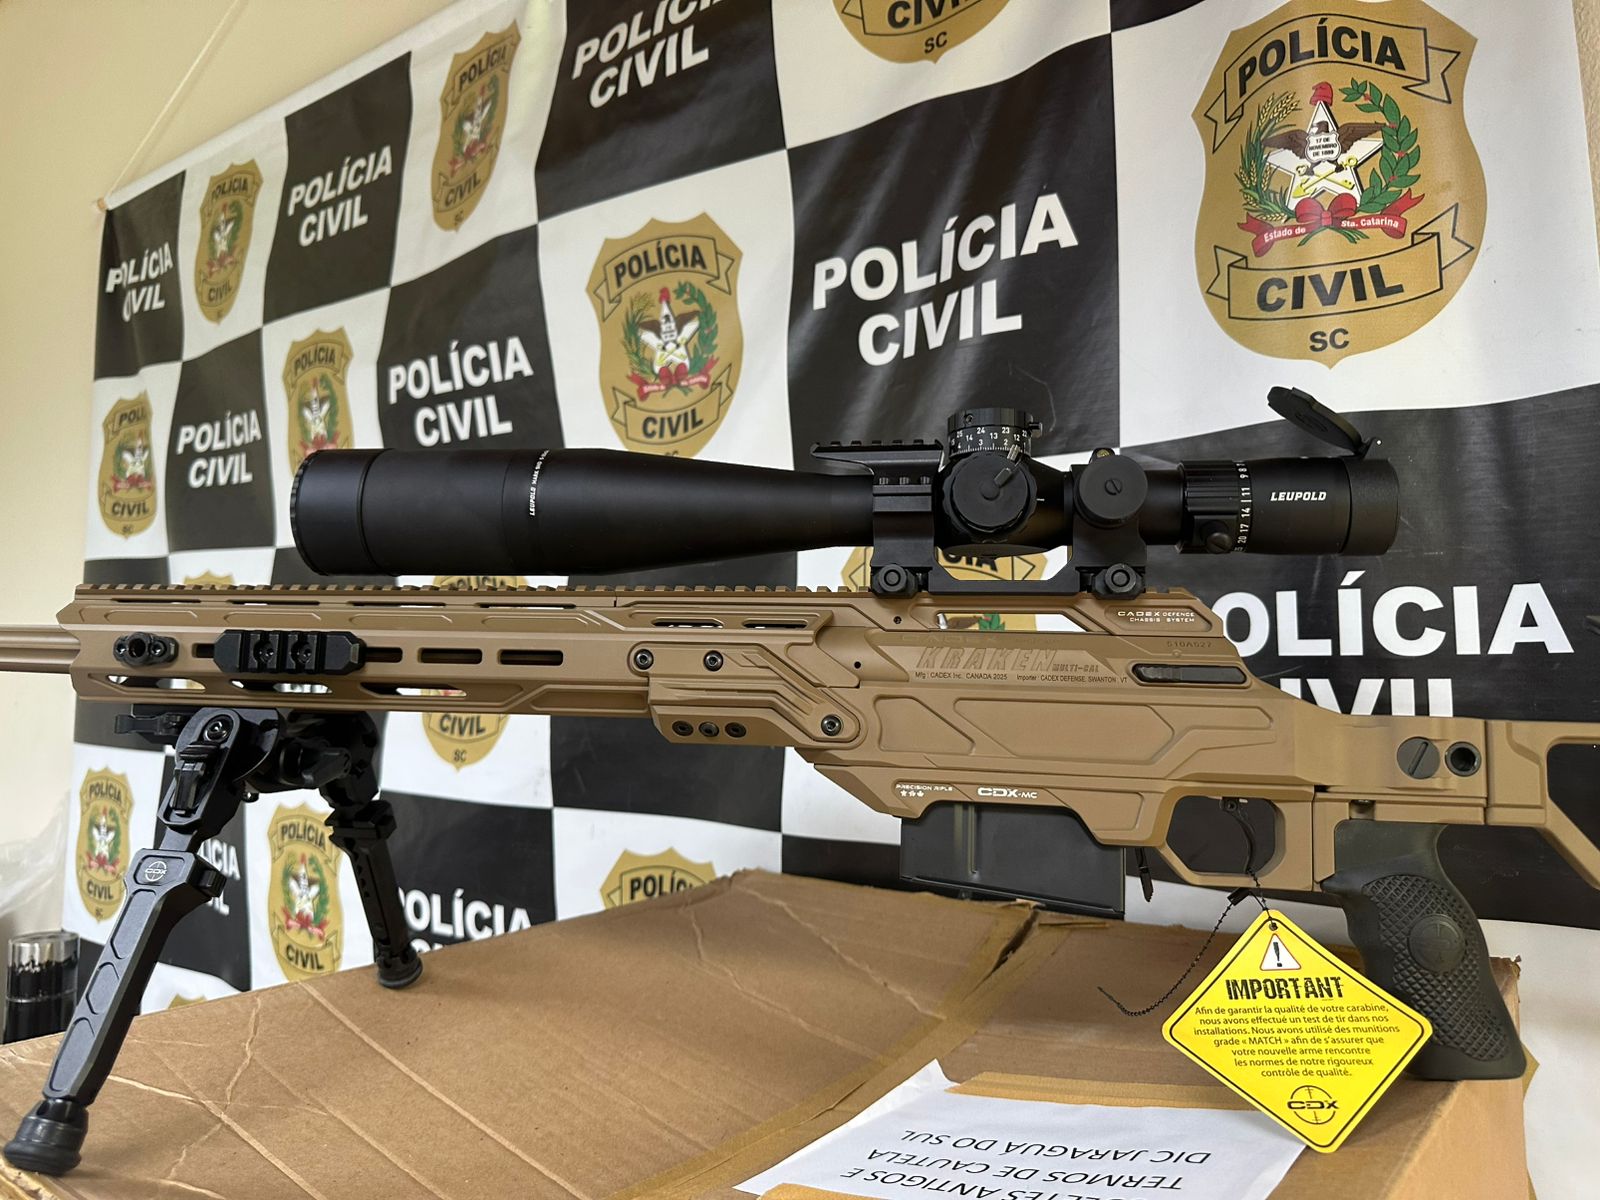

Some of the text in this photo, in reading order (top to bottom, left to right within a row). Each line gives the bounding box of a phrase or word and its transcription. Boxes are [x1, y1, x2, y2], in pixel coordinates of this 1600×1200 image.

[887, 0, 972, 30] CIV
[924, 31, 948, 54] SC
[590, 24, 709, 109] CIVIL
[1238, 17, 1406, 98] POLÍCIA
[288, 145, 392, 217] POLÍCIA
[444, 172, 481, 208] CIVIL
[299, 195, 368, 246] CIVIL
[1264, 227, 1292, 242] Estado
[1295, 226, 1306, 234] de
[1361, 216, 1399, 228] Catarina
[614, 240, 708, 289] POLÍCIA
[813, 192, 1078, 311] POLÍCIA
[208, 279, 233, 302] CIVIL
[1256, 263, 1404, 313] CIVIL
[858, 279, 1023, 367] CIVIL
[1309, 328, 1350, 352] SC
[294, 345, 337, 377] POLÍCIA
[388, 335, 534, 405] POLÍCIA
[176, 409, 263, 456] POLÍCIA
[415, 394, 514, 448] CIVIL
[642, 408, 704, 440] CIVIL
[990, 432, 998, 440] 13
[188, 452, 253, 489] CIVIL
[1240, 487, 1251, 497] 11
[1270, 491, 1327, 501] LEUPOLD
[111, 502, 150, 517] CIVIL
[1240, 507, 1250, 518] 14
[1239, 523, 1249, 533] 17
[1210, 570, 1575, 657] OLÍCIA
[916, 647, 1099, 673] KRAKEN MULTI-CAL
[1040, 674, 1059, 682] CADEX
[439, 713, 486, 737] CIVIL
[453, 749, 467, 762] SC
[88, 780, 123, 803] POLÍCIA
[280, 818, 326, 851] POLÍCIA
[86, 879, 115, 900] CIVIL
[398, 886, 532, 941] OLÍCIA
[285, 943, 325, 971] CIVIL
[1225, 976, 1344, 1000] IMPORTANT
[1195, 1006, 1213, 1014] Afin
[1214, 1006, 1225, 1014] de
[1227, 1006, 1262, 1016] garantir
[1274, 1005, 1305, 1014] qualité
[1307, 1004, 1318, 1012] de
[1346, 1003, 1389, 1012] carabine,
[1251, 1015, 1287, 1024] effectué
[1303, 1015, 1320, 1023] test
[1322, 1014, 1333, 1023] de
[1336, 1014, 1345, 1022] tir
[1347, 1014, 1370, 1022] dans
[1194, 1026, 1250, 1035] installations.
[1251, 1026, 1274, 1034] Nous
[1305, 1025, 1332, 1033] utilisé
[1334, 1025, 1350, 1033] des
[1352, 1024, 1400, 1032] munitions
[1214, 1037, 1240, 1047] grade
[1248, 1036, 1282, 1044] MATCH
[1291, 1036, 1308, 1044] afin
[1310, 1036, 1322, 1044] de
[1365, 1037, 1384, 1045] que
[1234, 1058, 1247, 1066] les
[1286, 1057, 1298, 1065] de
[1327, 1057, 1373, 1067] rigoureux
[1257, 1047, 1297, 1055] nouvelle
[1261, 1067, 1352, 1077] contrôle de qualité.
[901, 1130, 1211, 1164] DIC JARAGUÁ DO SUL
[840, 1167, 865, 1178] E
[867, 1149, 1183, 1189] TERMOS DE CAUTELA
[863, 1170, 1002, 1198] ANTIGOS
